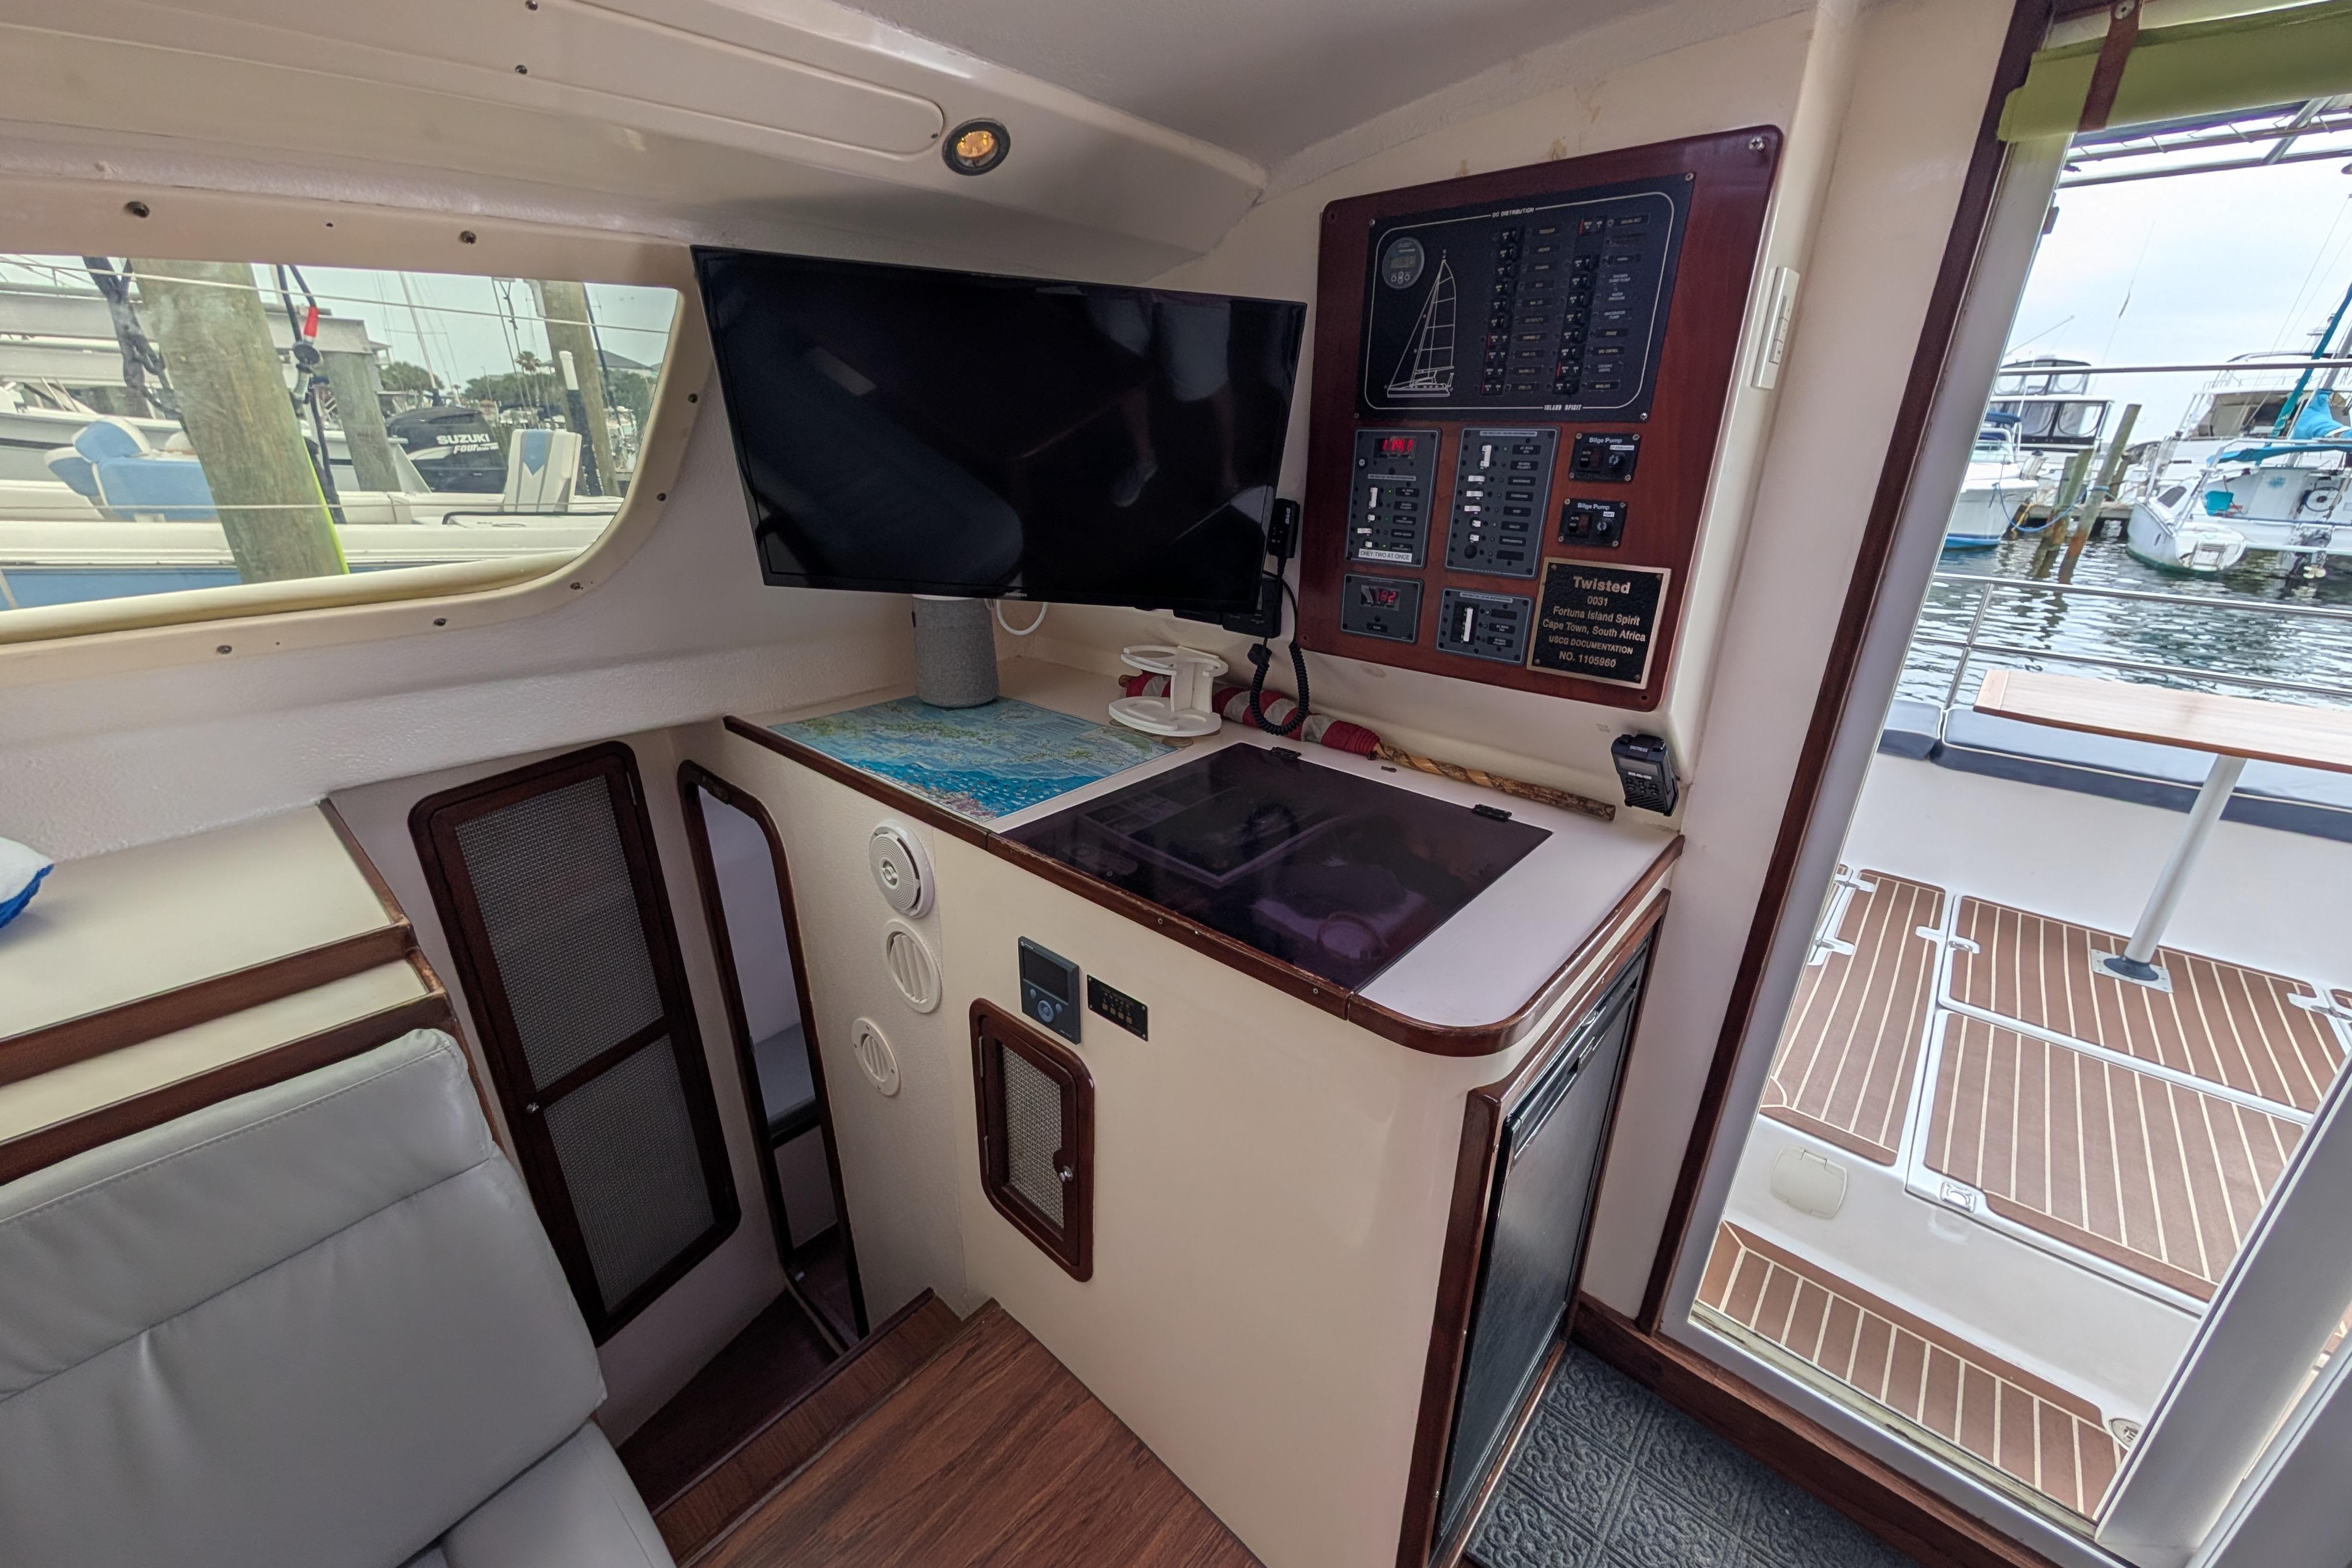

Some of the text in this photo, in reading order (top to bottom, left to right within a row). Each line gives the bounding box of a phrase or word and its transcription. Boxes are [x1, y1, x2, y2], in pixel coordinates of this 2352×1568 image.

[436, 434, 490, 444] SUZUKI
[1573, 575, 1630, 594] Twisted
[1587, 595, 1608, 606] 0031
[1553, 606, 1640, 626] Fortuna Island Spirit
[1543, 619, 1646, 642] Cape Town, South Africa
[1549, 635, 1633, 655] USCG DOCUMENTATION
[1559, 650, 1616, 668] NO. 1105960
